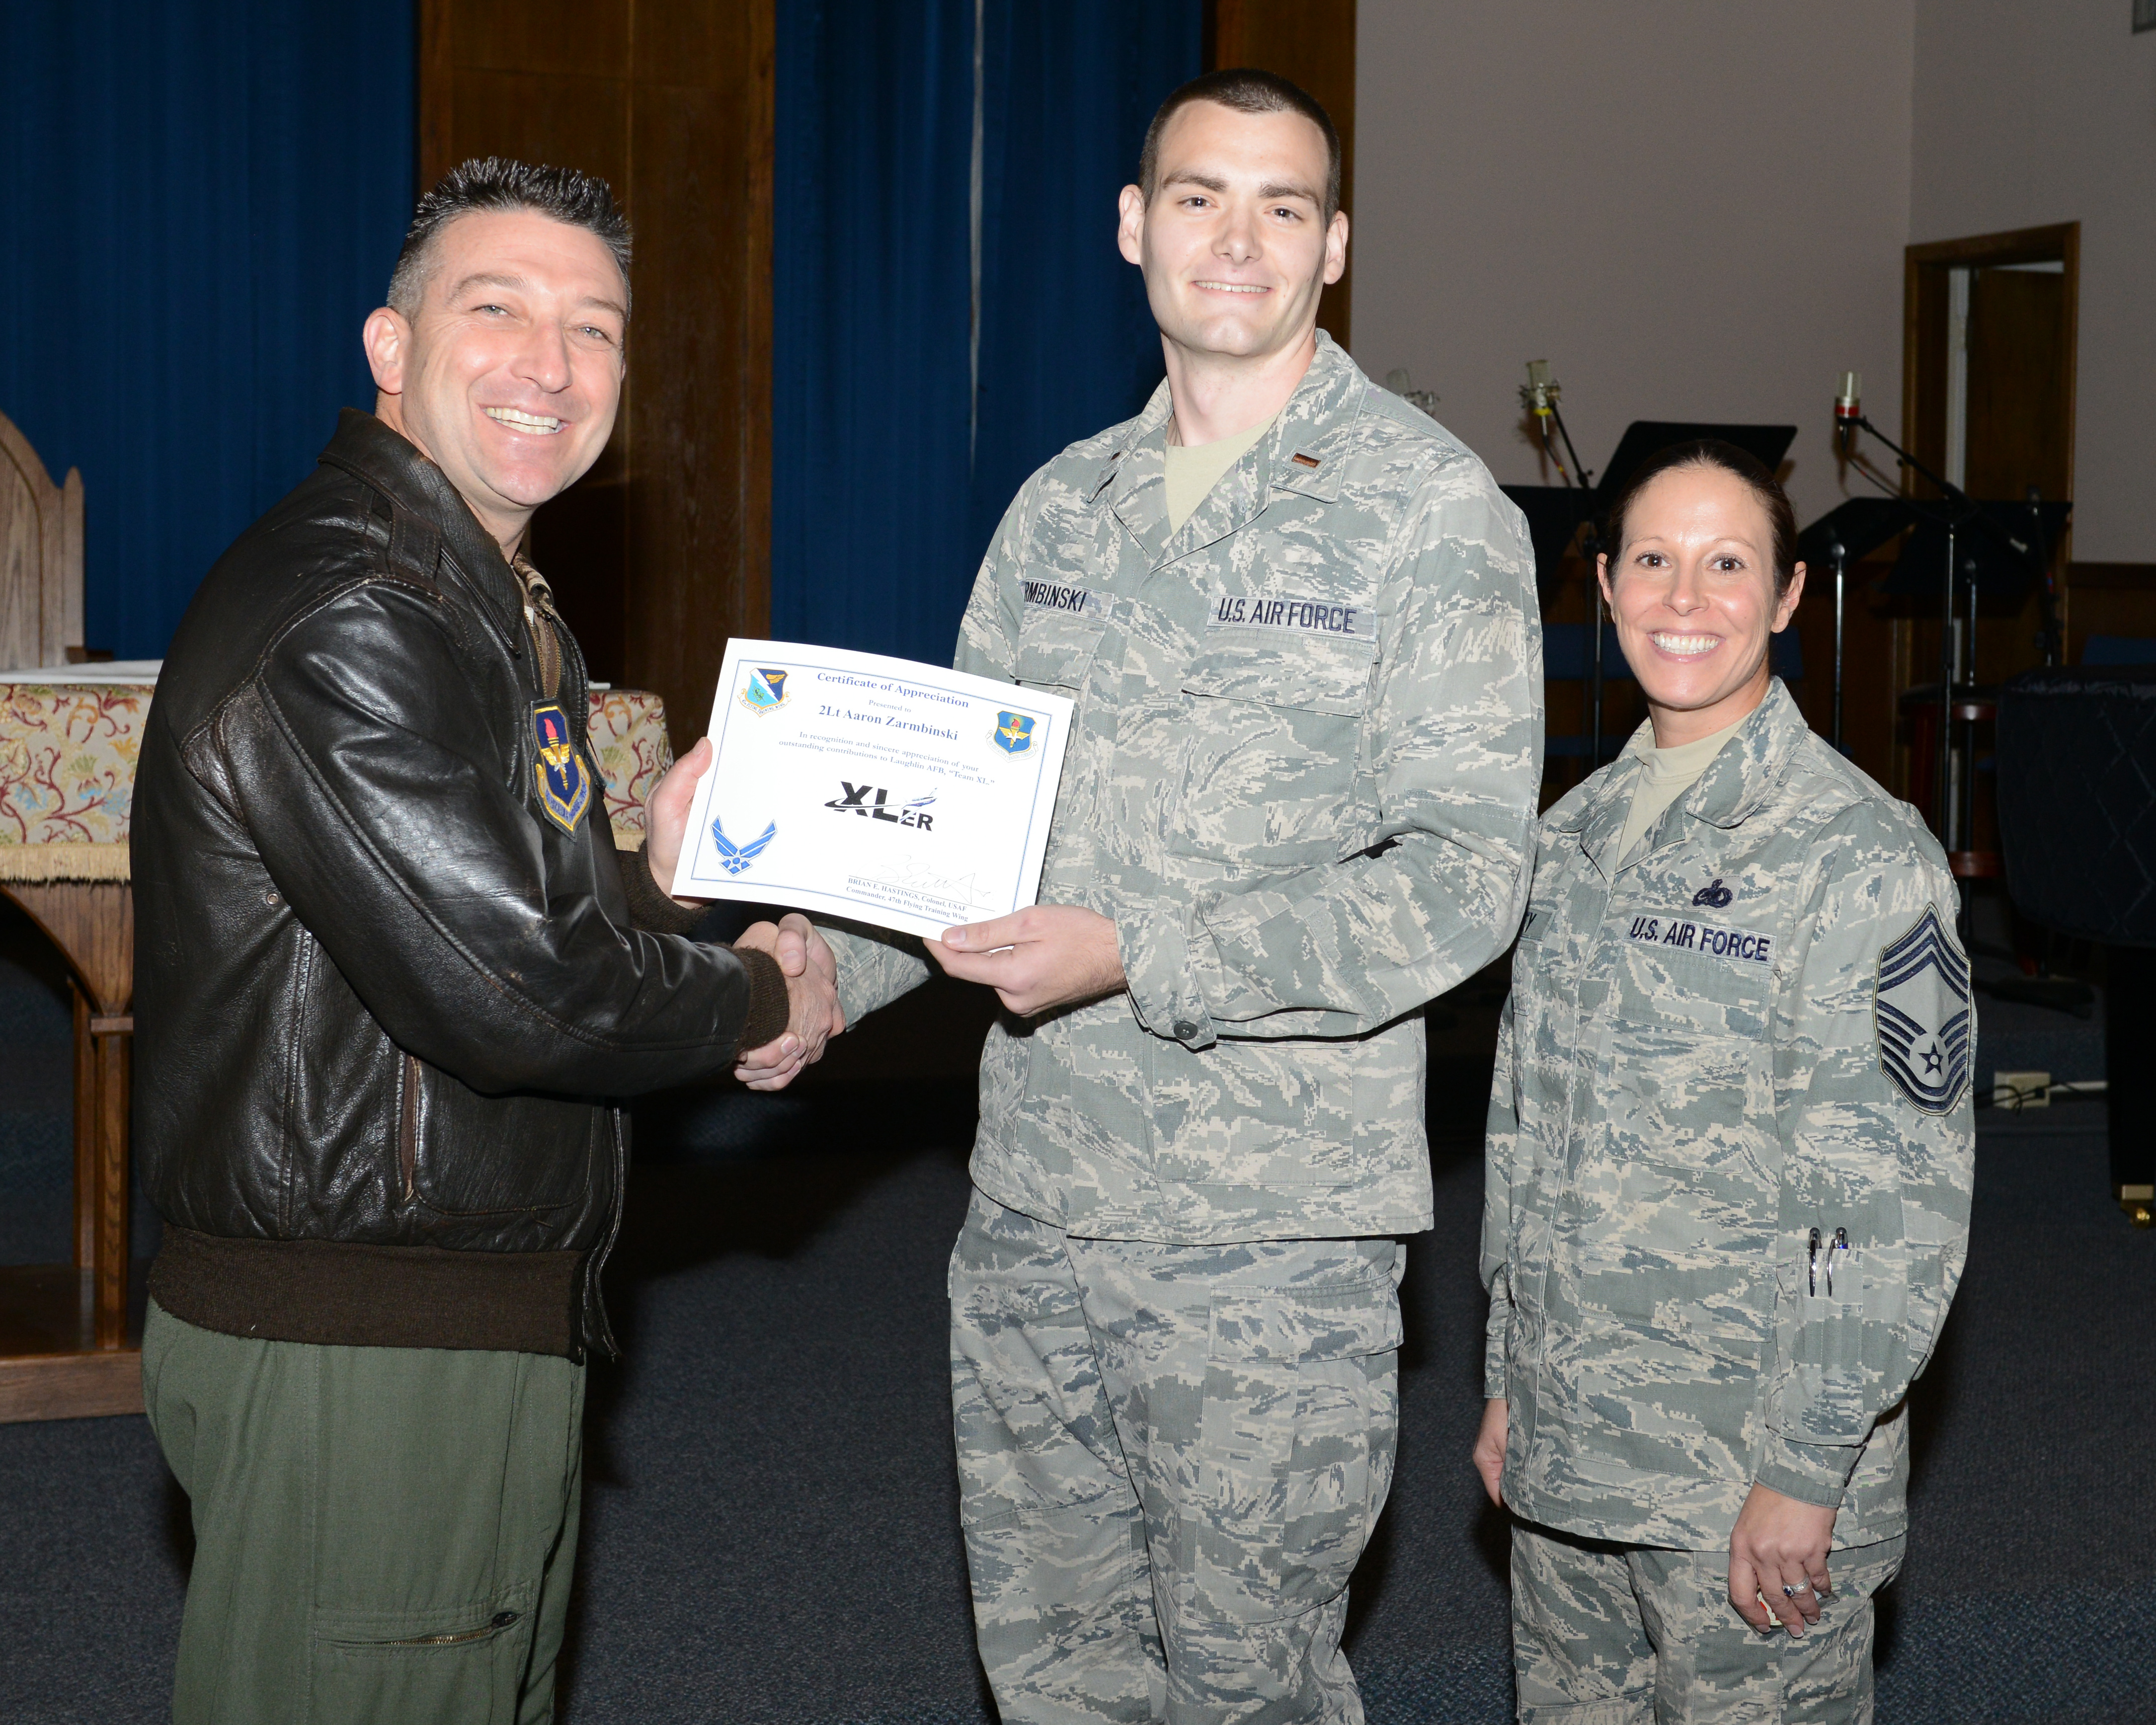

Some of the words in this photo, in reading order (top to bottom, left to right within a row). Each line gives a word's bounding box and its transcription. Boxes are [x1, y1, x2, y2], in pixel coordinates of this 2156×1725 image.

[1218, 598, 1245, 622] U.S.
[1249, 599, 1284, 625] AIR
[1288, 602, 1357, 634] FORCE
[817, 672, 877, 689] Certificate
[895, 685, 969, 708] Appreciation
[868, 699, 903, 711] Presented
[819, 705, 841, 717] 2Lt
[843, 709, 882, 724] Aaron
[886, 716, 958, 741] Zarmbinski
[779, 741, 825, 752] outstanding
[827, 747, 877, 759] contributions
[890, 756, 924, 769] Laughlin
[927, 765, 946, 775] AFB,
[949, 769, 974, 781] “Team
[810, 734, 853, 745] recognition
[872, 743, 900, 754] sincere
[902, 751, 949, 765] appreciation
[846, 887, 886, 901] Commander,
[888, 896, 902, 904] 47th
[903, 900, 923, 911] Flying
[924, 905, 950, 917] Training
[952, 912, 968, 922] Wing
[848, 878, 871, 888] BRIAN
[882, 886, 920, 901] HASTINGS,
[922, 896, 946, 907] Colonel,
[948, 902, 967, 912] USAF
[1630, 917, 1658, 942] U.S.
[1663, 922, 1696, 948] AIR
[1699, 928, 1771, 962] FORCE
